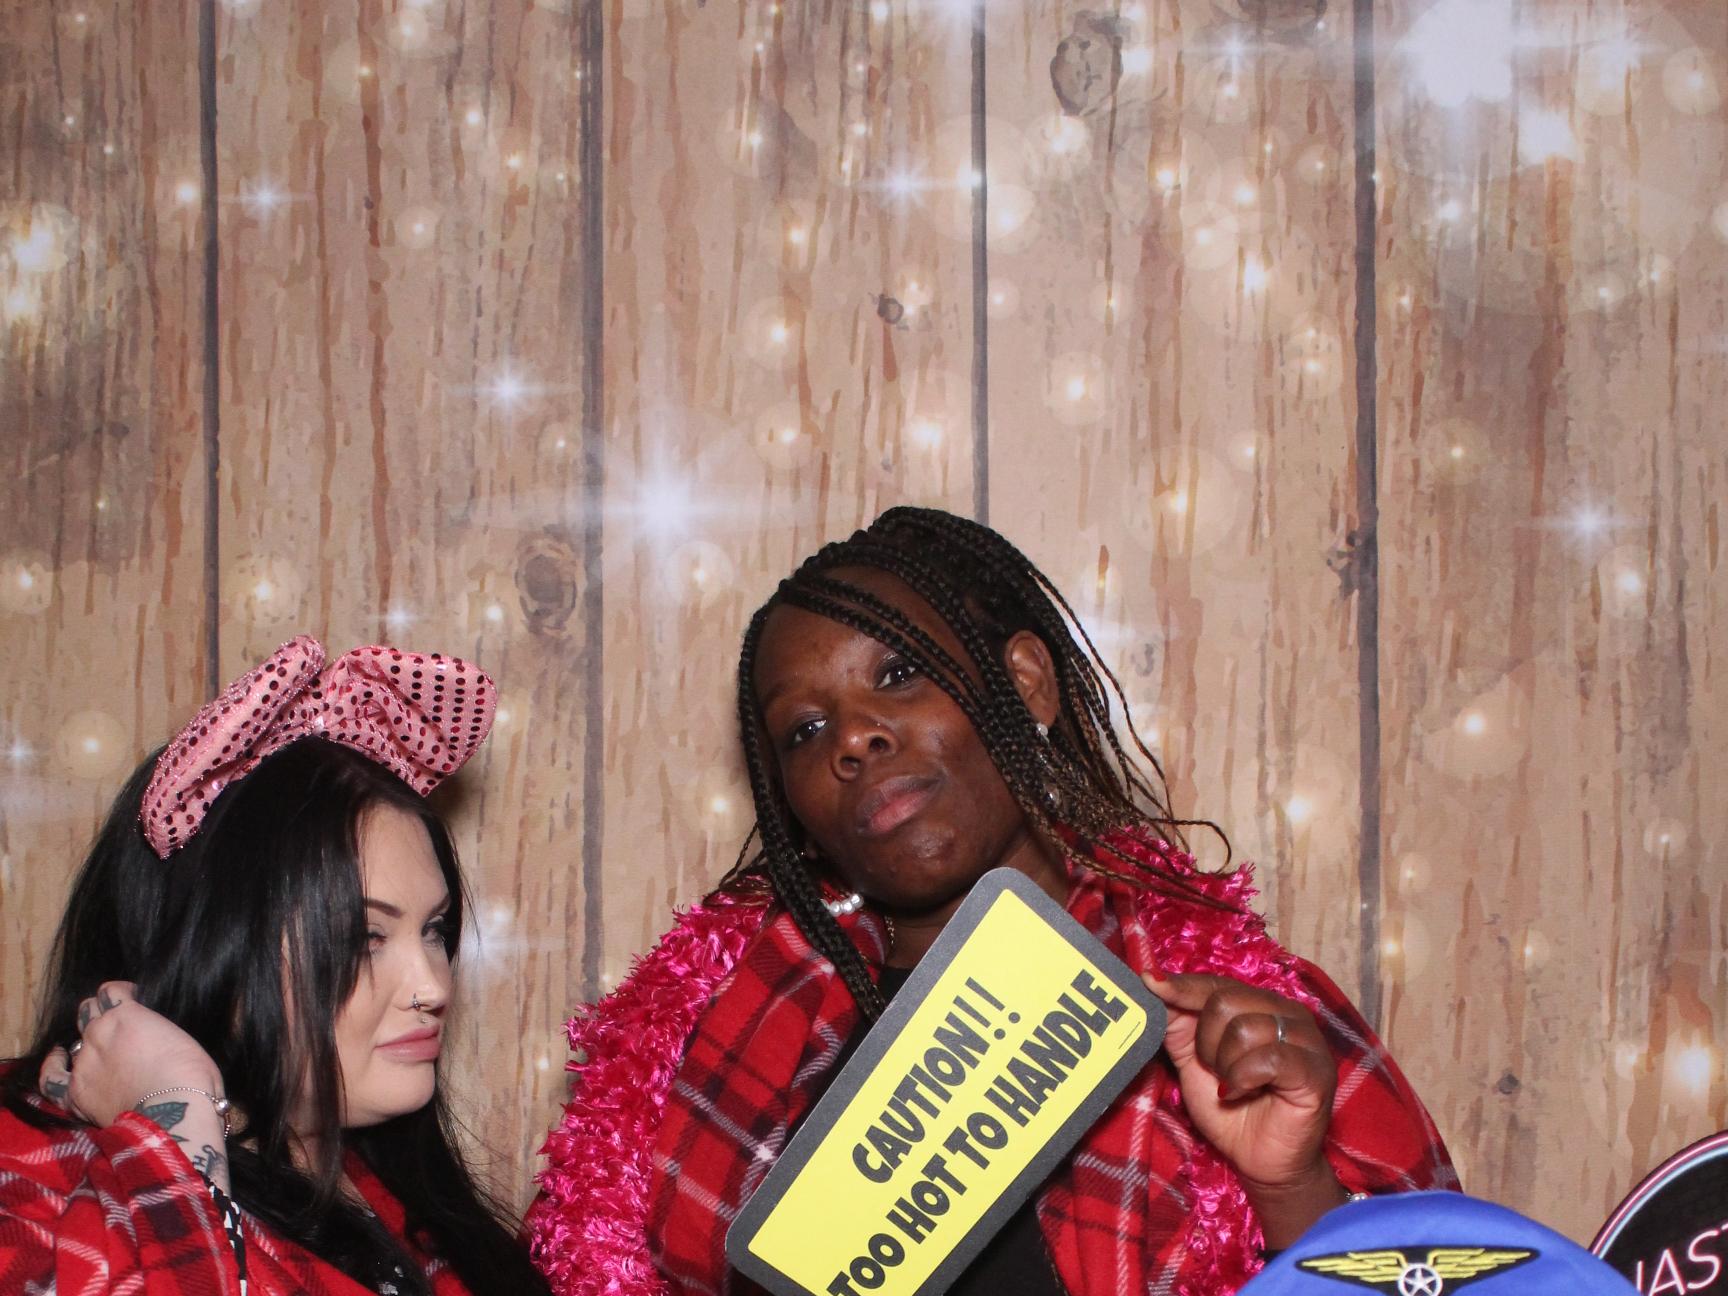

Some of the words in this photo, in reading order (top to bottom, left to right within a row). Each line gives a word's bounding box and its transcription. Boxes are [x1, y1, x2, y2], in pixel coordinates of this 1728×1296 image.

[852, 976, 1022, 1184] CAUTION!!
[886, 1155, 969, 1245] HOT
[944, 1111, 1009, 1171] TO
[985, 969, 1130, 1128] HANDLE
